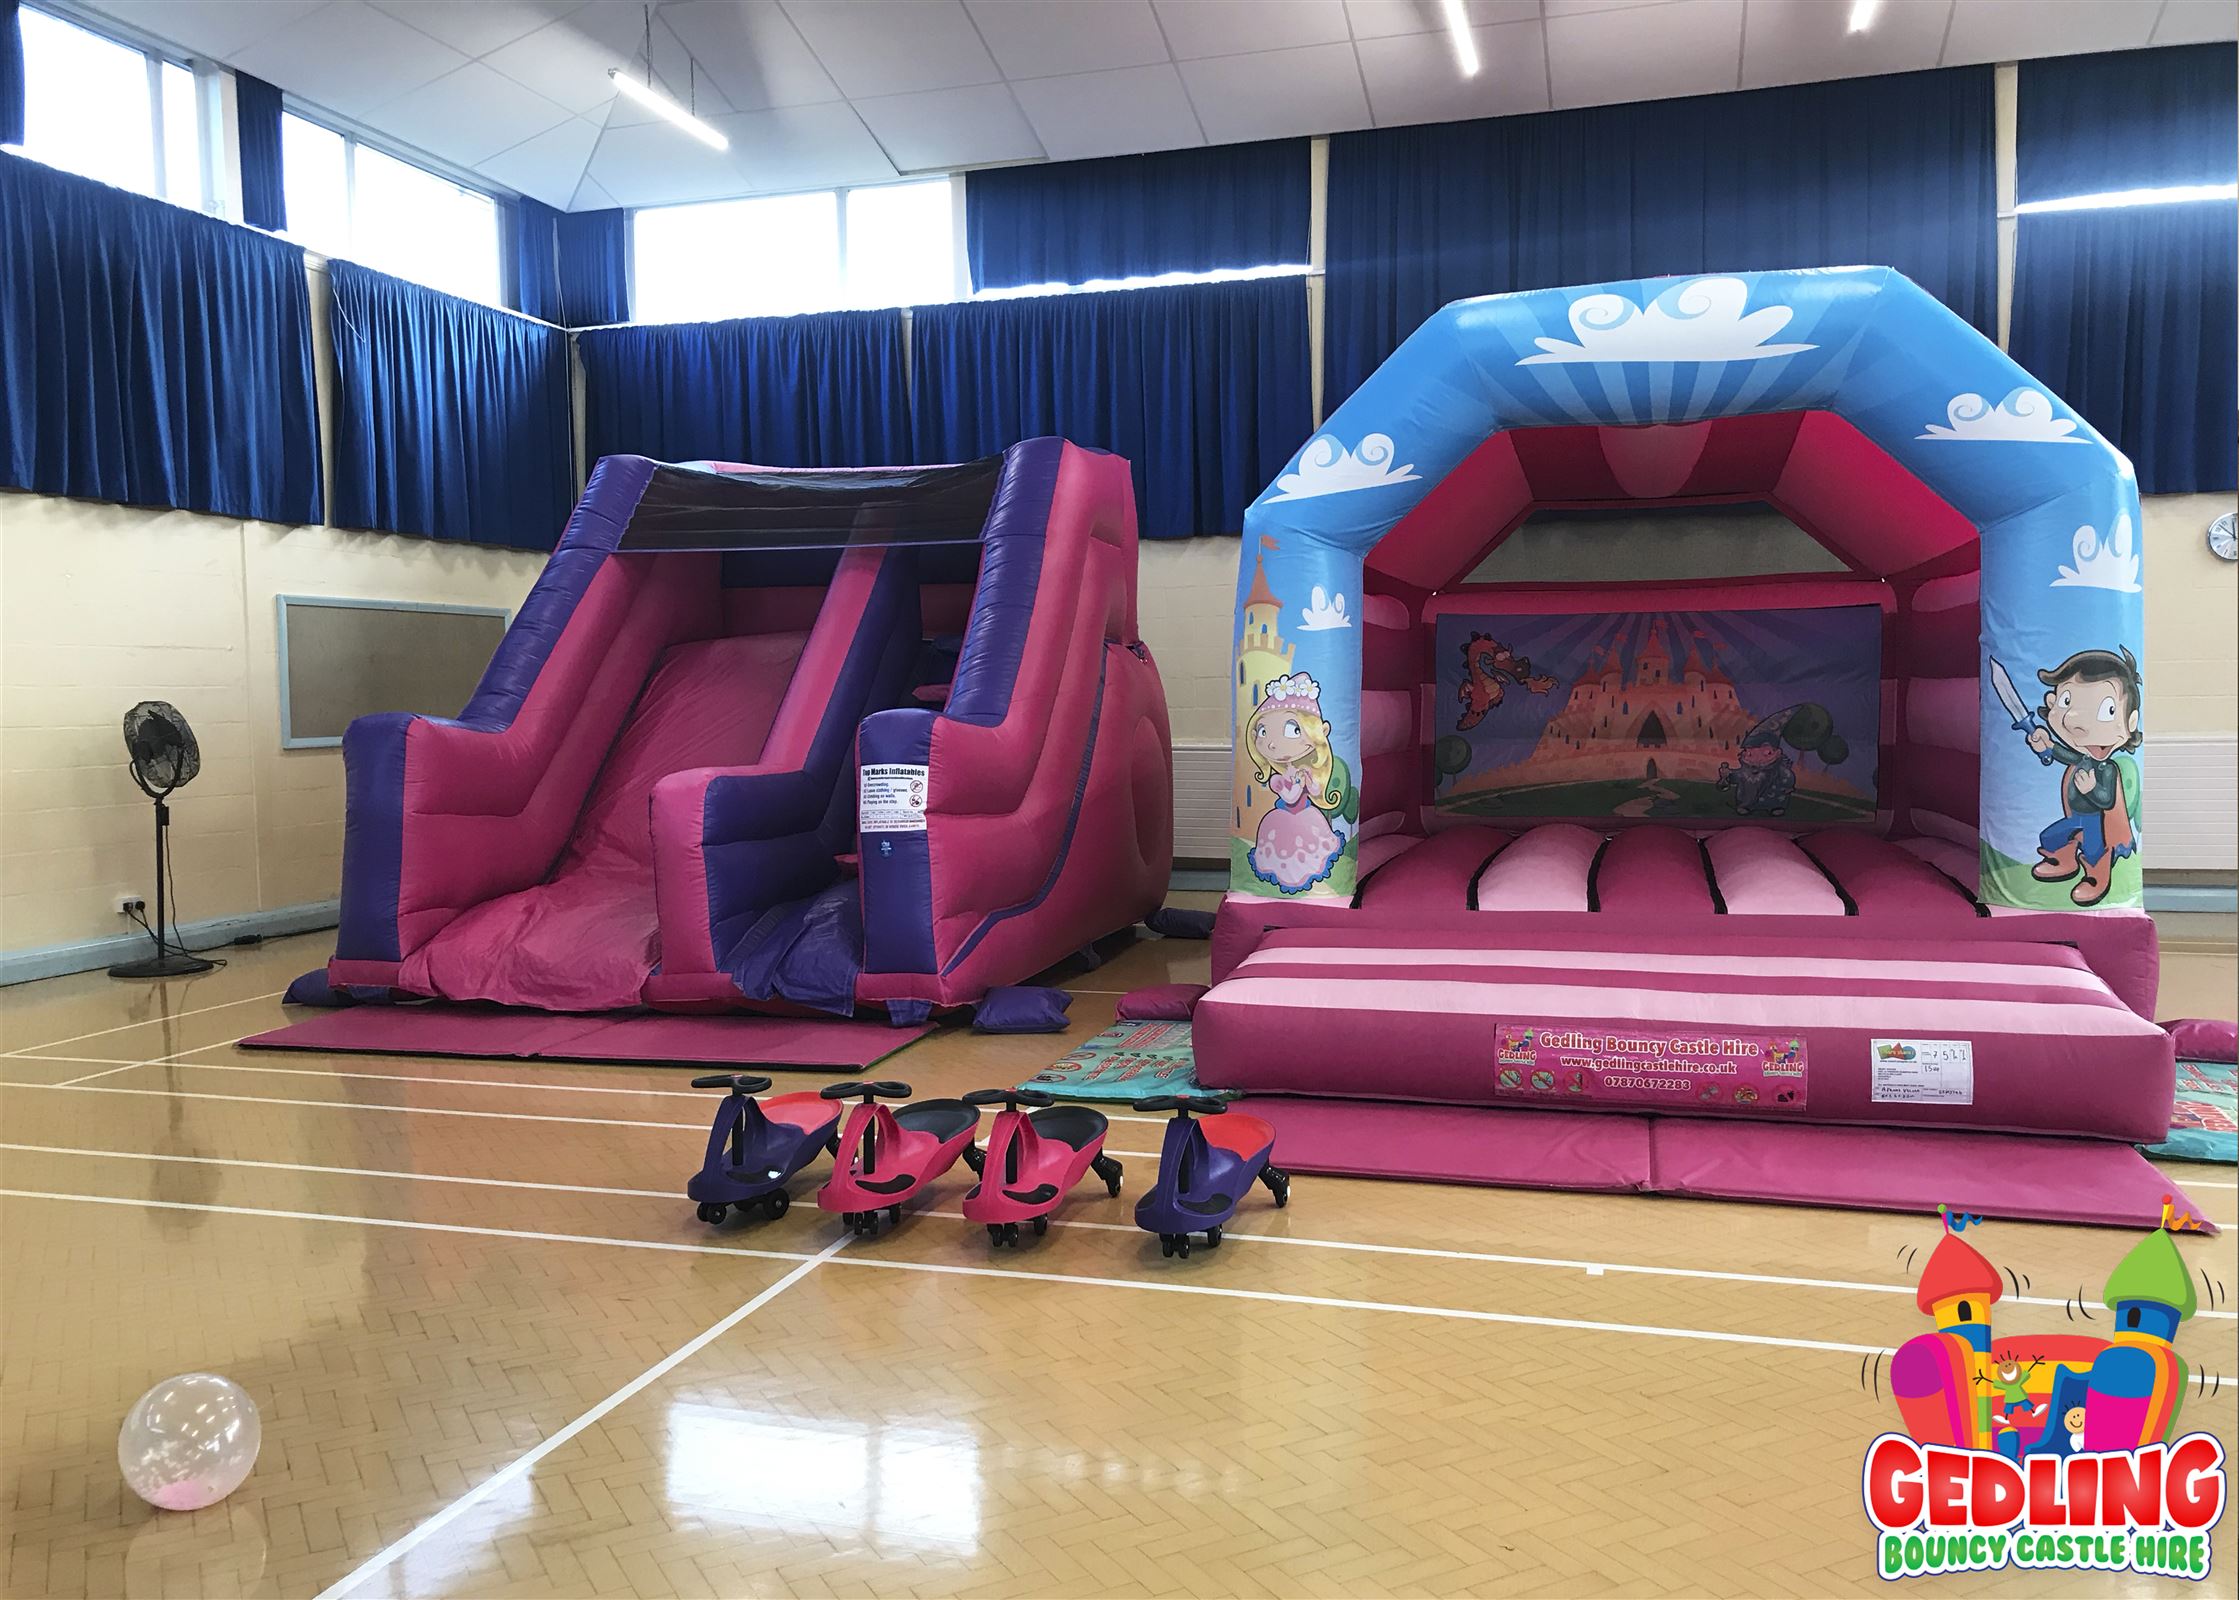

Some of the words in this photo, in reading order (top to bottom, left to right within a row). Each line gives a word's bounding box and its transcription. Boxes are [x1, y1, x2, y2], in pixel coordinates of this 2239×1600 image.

[871, 768, 888, 776] Marks
[889, 768, 925, 776] Inflatables
[1540, 1032, 1603, 1054] Gedling
[1606, 1036, 1667, 1057] Bouncy
[1669, 1038, 1720, 1055] Castle
[1722, 1039, 1758, 1056] Hire
[1498, 1049, 1537, 1061] GEDLING
[1560, 1056, 1737, 1075] www.gedlingcastlehire.co.uk
[1762, 1061, 1804, 1073] GEDLING
[1604, 1076, 1691, 1091] 07870672283
